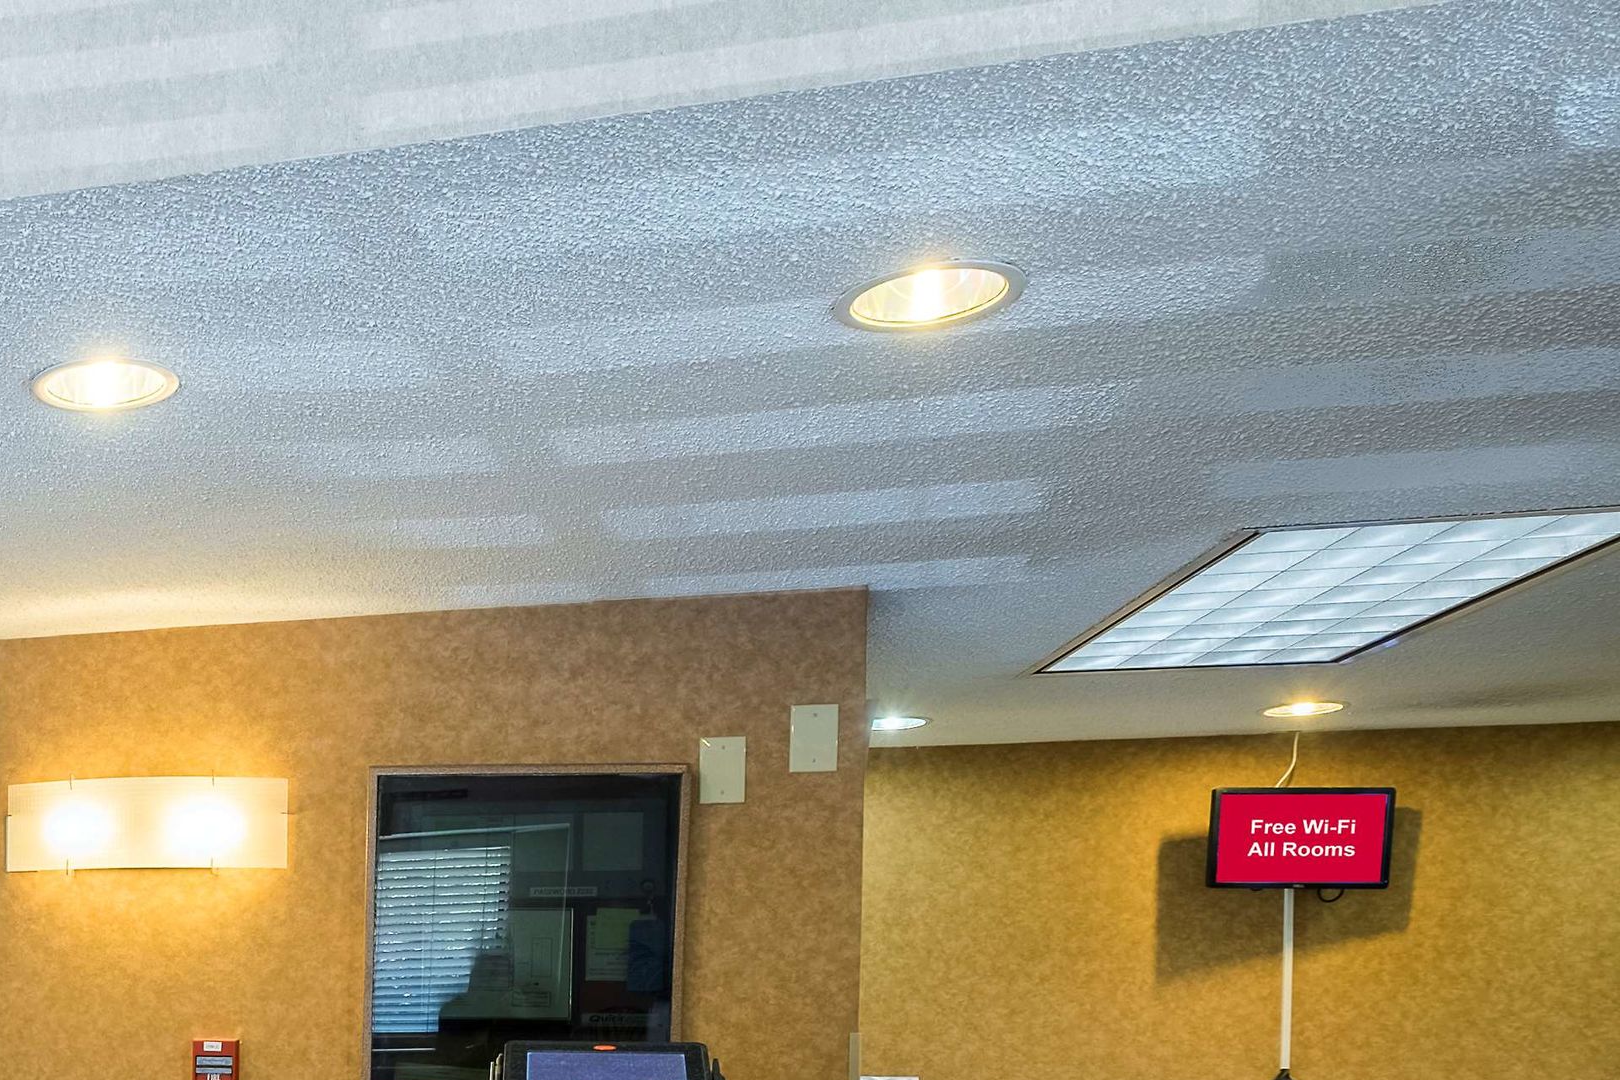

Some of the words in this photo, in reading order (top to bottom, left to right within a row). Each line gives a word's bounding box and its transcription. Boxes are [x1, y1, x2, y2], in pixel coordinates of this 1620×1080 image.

[1250, 819, 1296, 835] Free
[1302, 819, 1356, 835] Wi-Fi
[1247, 842, 1275, 857] All
[1282, 842, 1356, 857] Rooms
